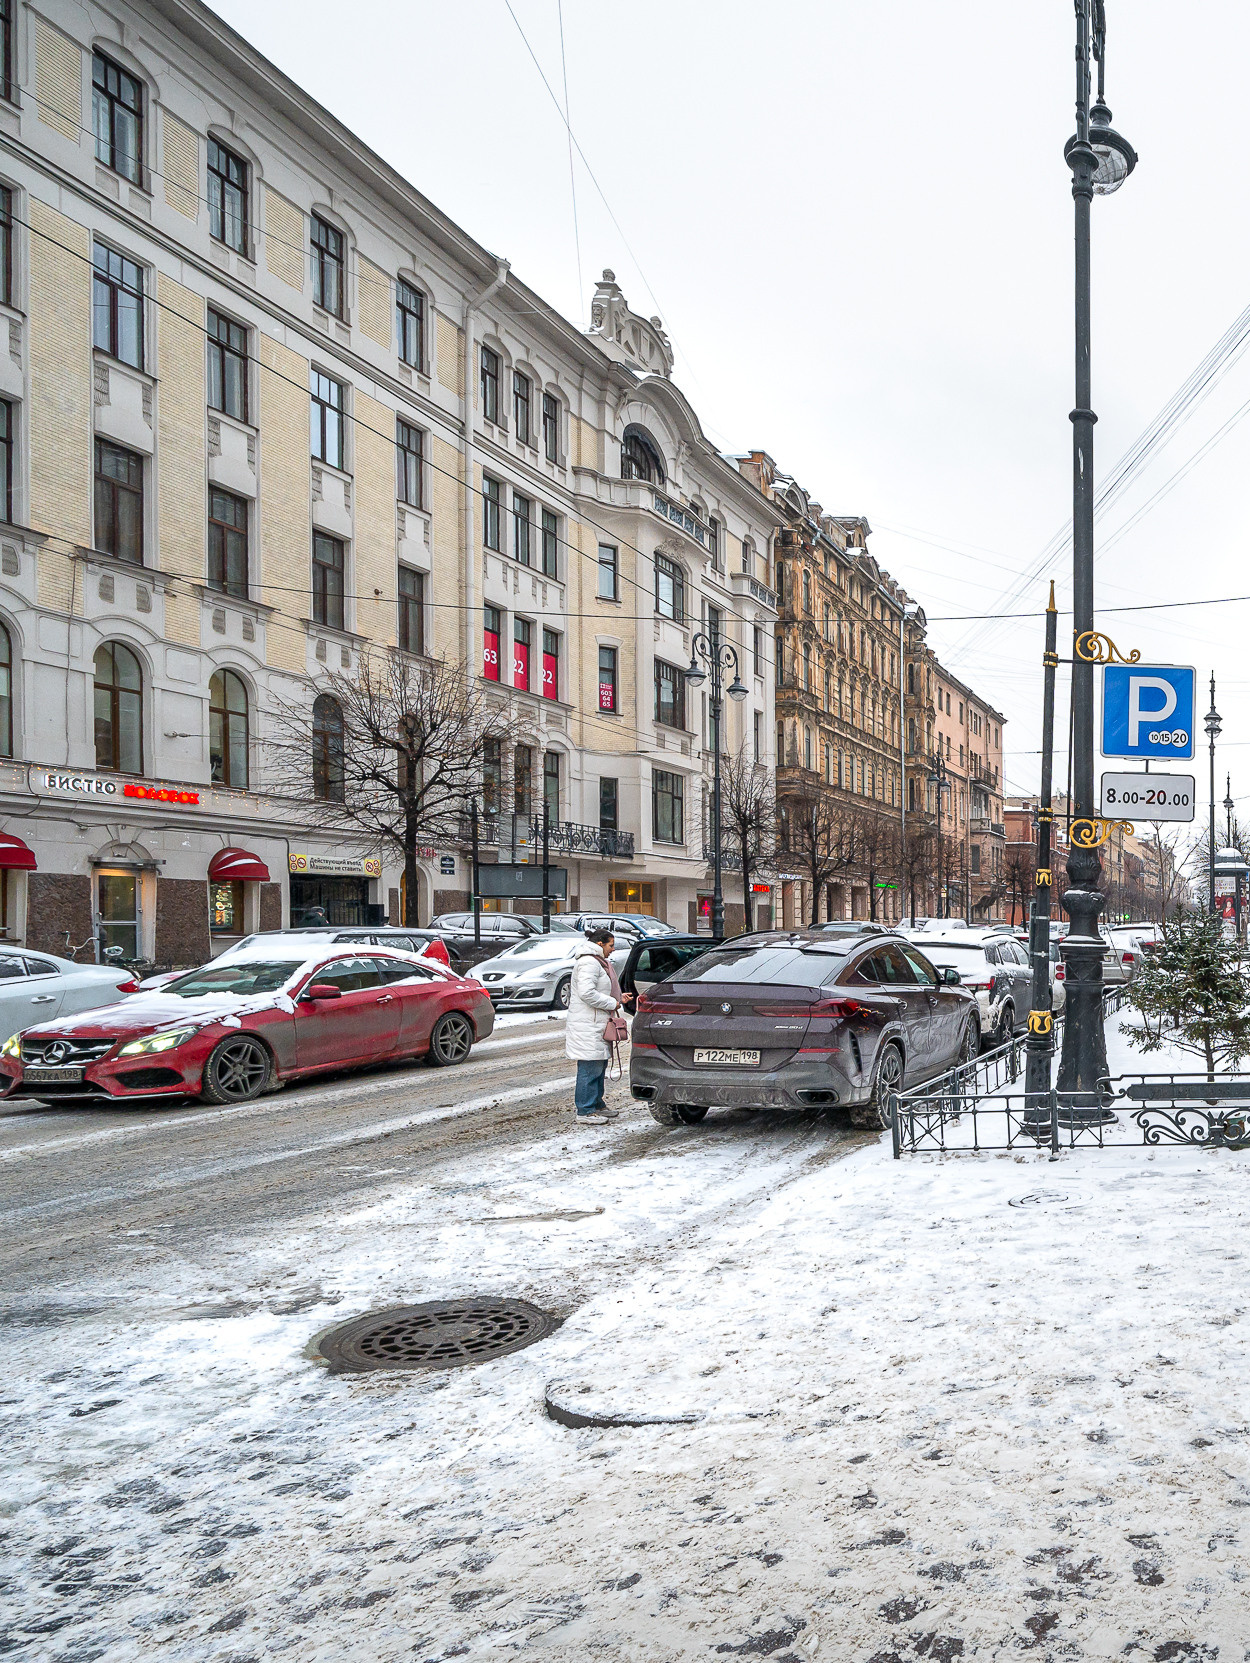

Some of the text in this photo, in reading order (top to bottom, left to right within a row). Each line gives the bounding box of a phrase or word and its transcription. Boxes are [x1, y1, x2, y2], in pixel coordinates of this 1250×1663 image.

[484, 648, 498, 664] 63
[1128, 676, 1178, 747] P
[1161, 733, 1170, 742] 15
[1173, 733, 1187, 744] 20
[44, 774, 117, 795] БИСТРО
[1106, 788, 1189, 807] 8.00-20.00
[697, 1051, 757, 1062] Р122МЕ 198
[26, 1070, 80, 1080] О567КА 198
